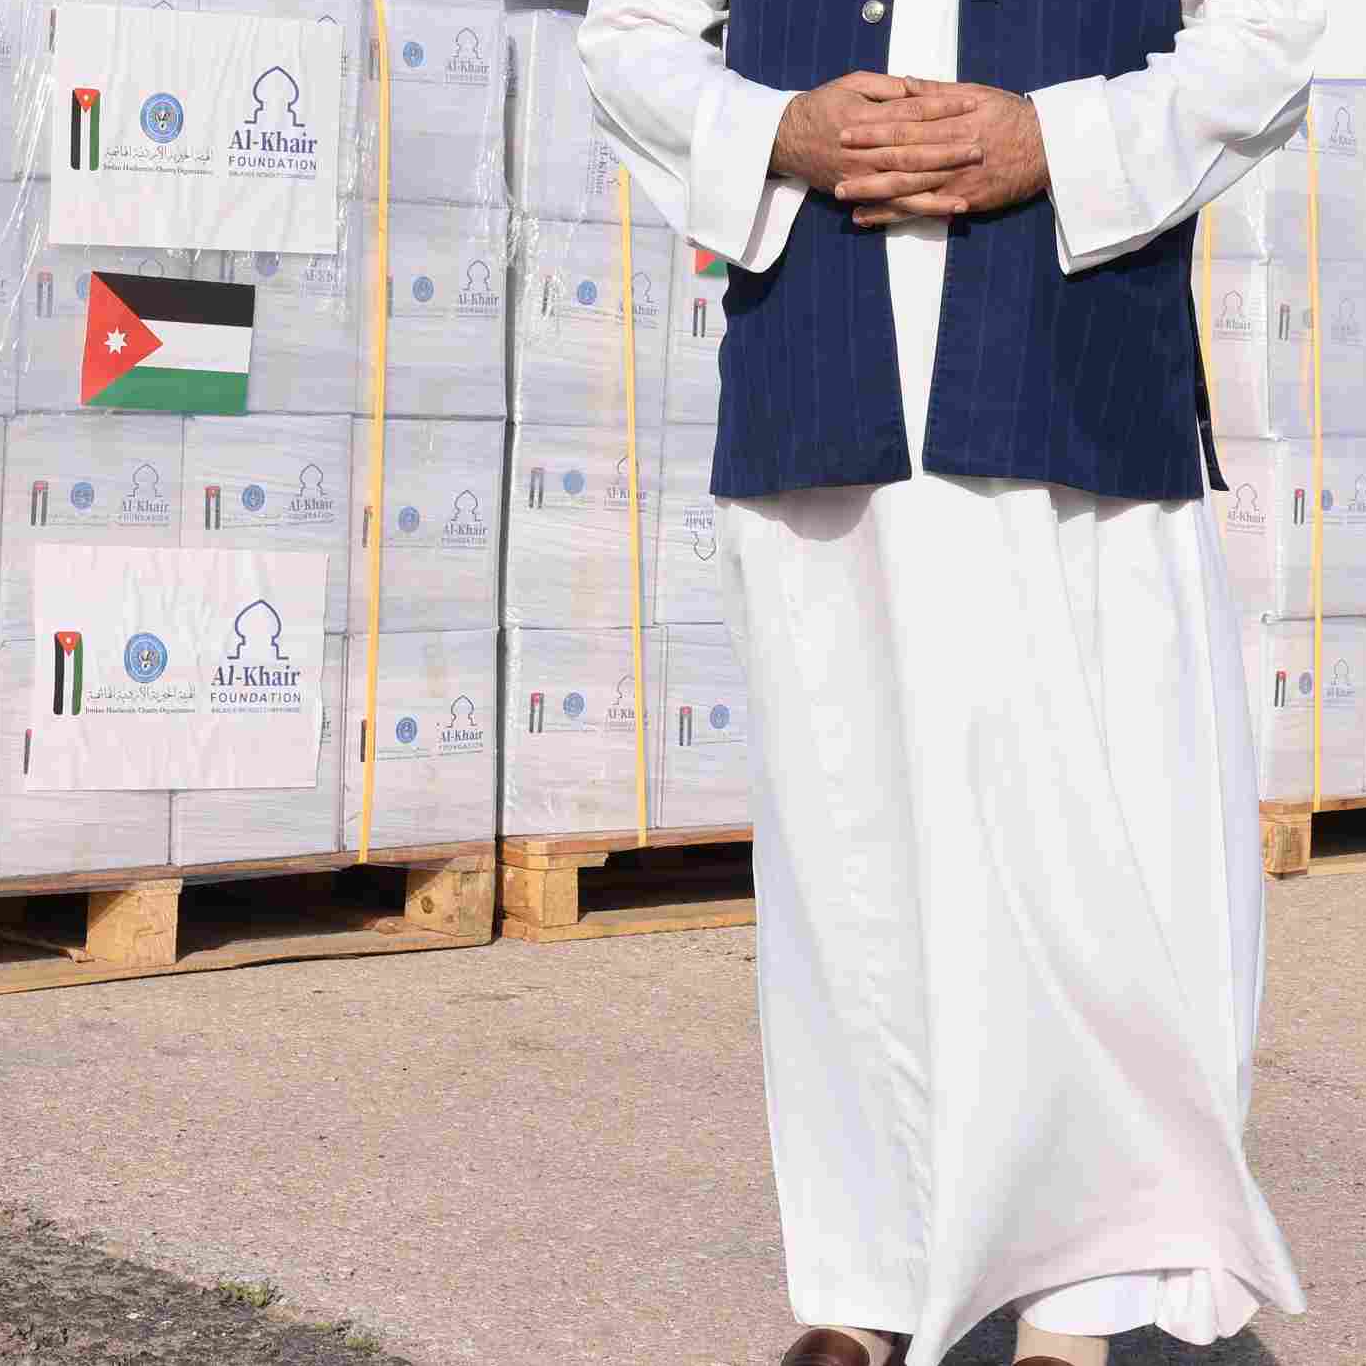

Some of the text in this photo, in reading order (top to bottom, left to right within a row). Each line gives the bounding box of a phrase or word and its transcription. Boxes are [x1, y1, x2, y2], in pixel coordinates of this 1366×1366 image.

[228, 129, 317, 154] Al-Khair
[228, 155, 317, 171] FOUNDATION
[122, 499, 170, 513] Al-Khair
[211, 666, 301, 687] Al-Khair
[210, 692, 301, 704] FOUNDATION
[439, 729, 483, 743] Al-Khair
